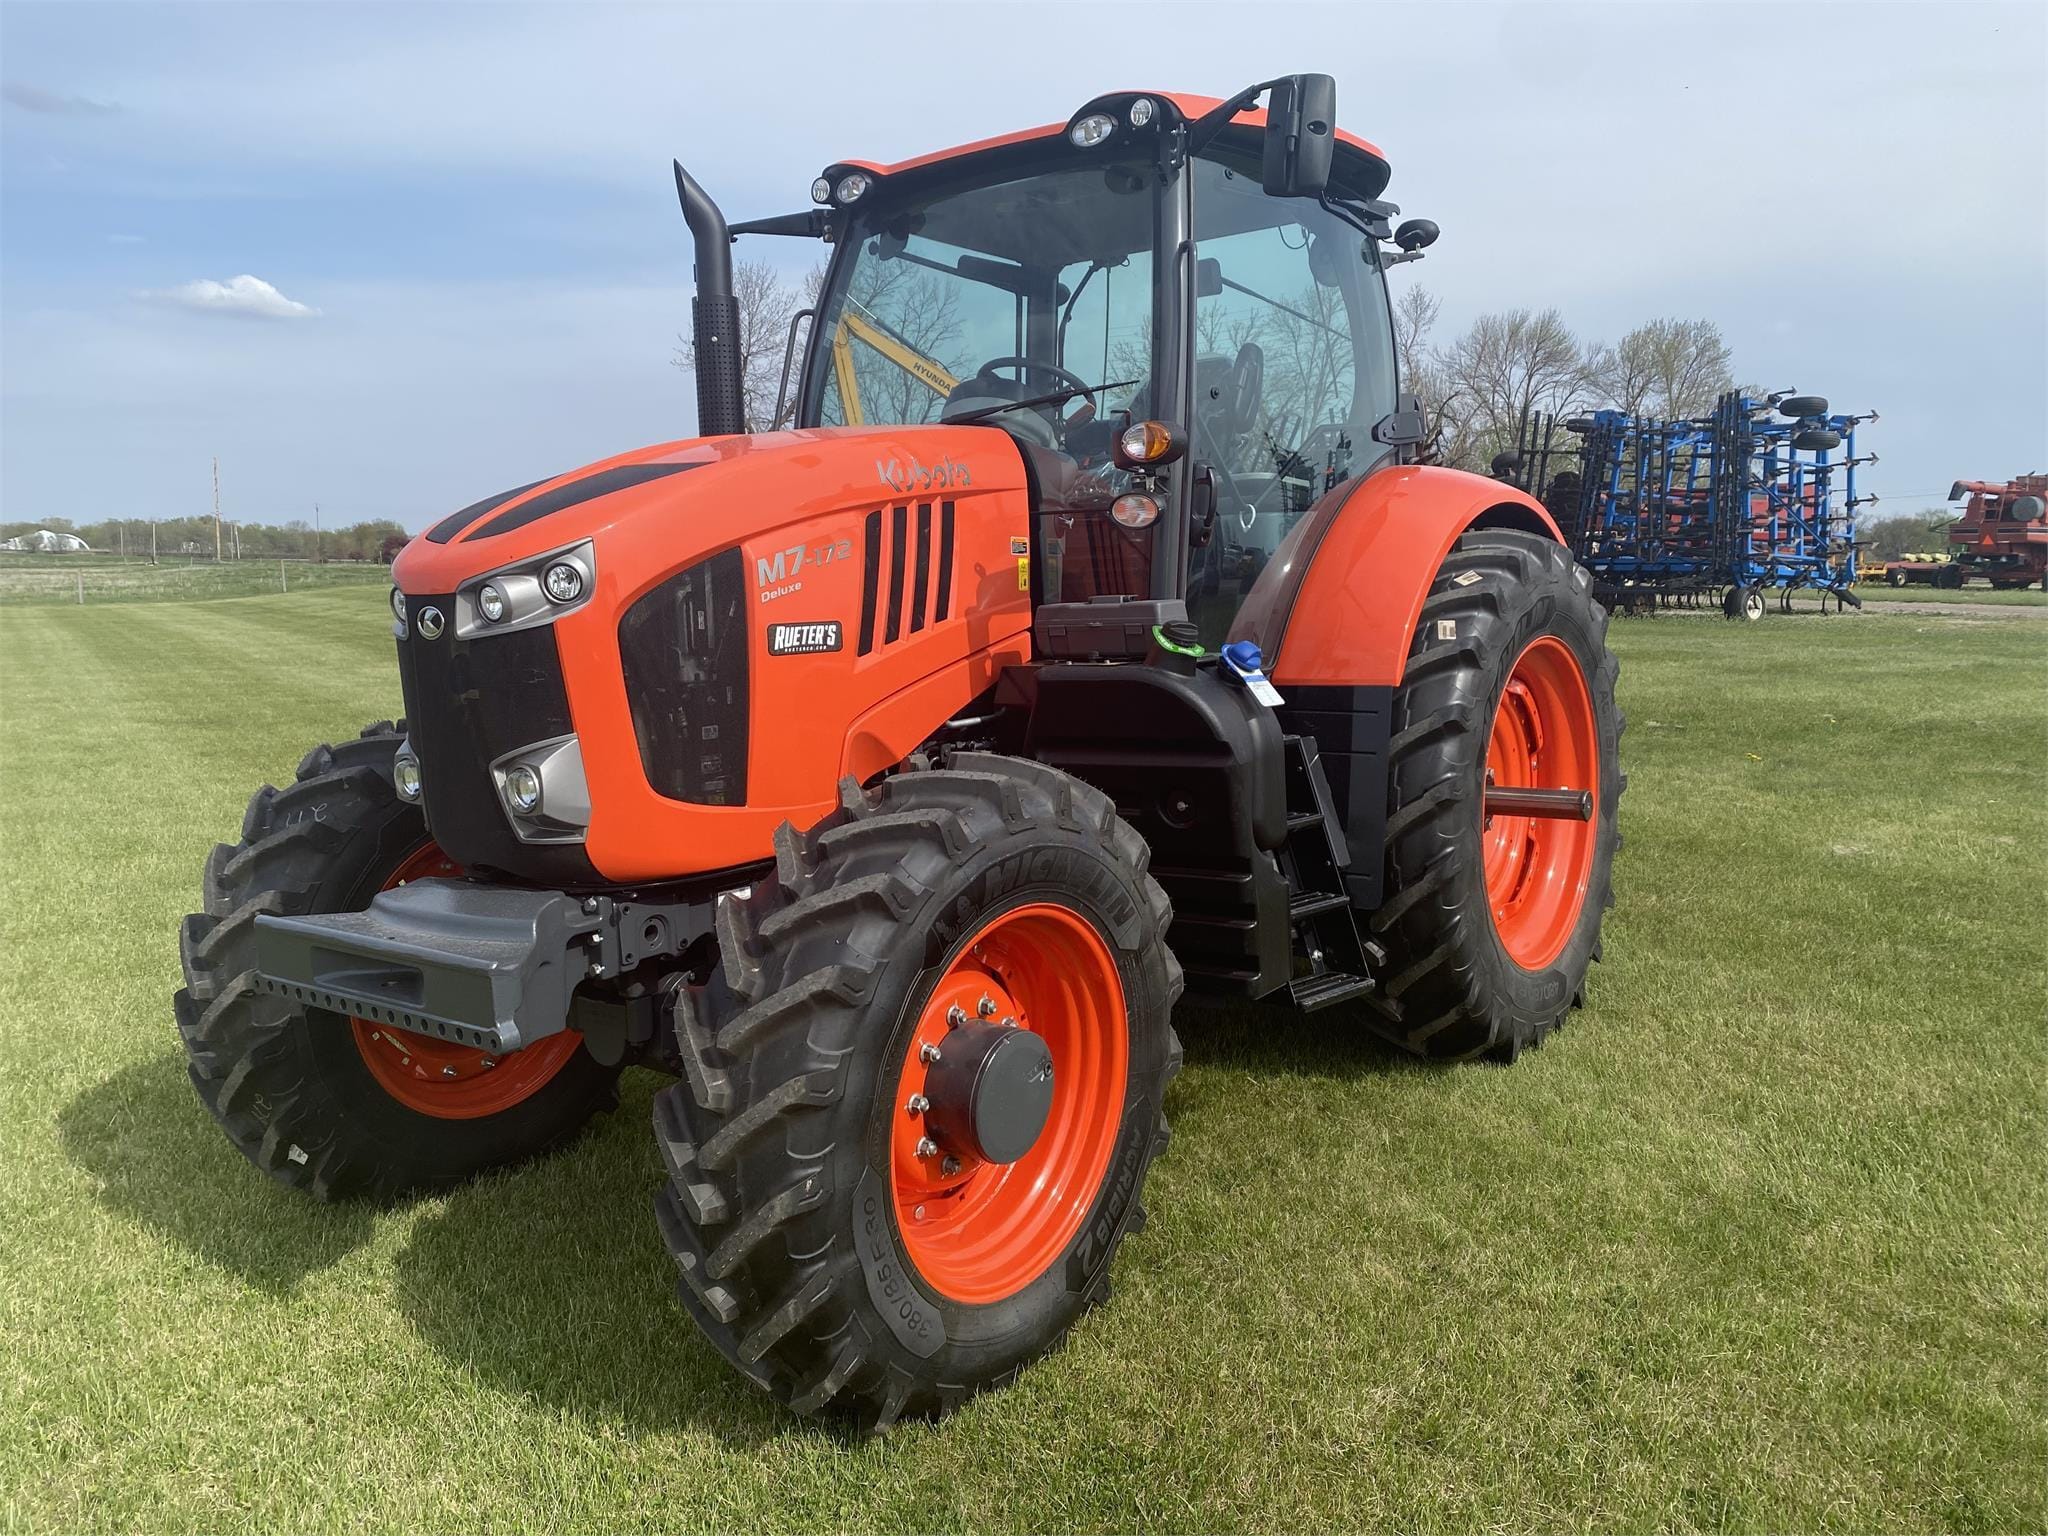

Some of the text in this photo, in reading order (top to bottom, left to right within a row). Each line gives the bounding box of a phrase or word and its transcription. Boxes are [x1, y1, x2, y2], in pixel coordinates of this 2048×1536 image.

[913, 362, 951, 391] HYUNDA
[876, 456, 971, 492] Kubota
[761, 580, 802, 604] Deluxe
[774, 624, 837, 650] RUETER'S
[984, 850, 1137, 928] MICHELIN
